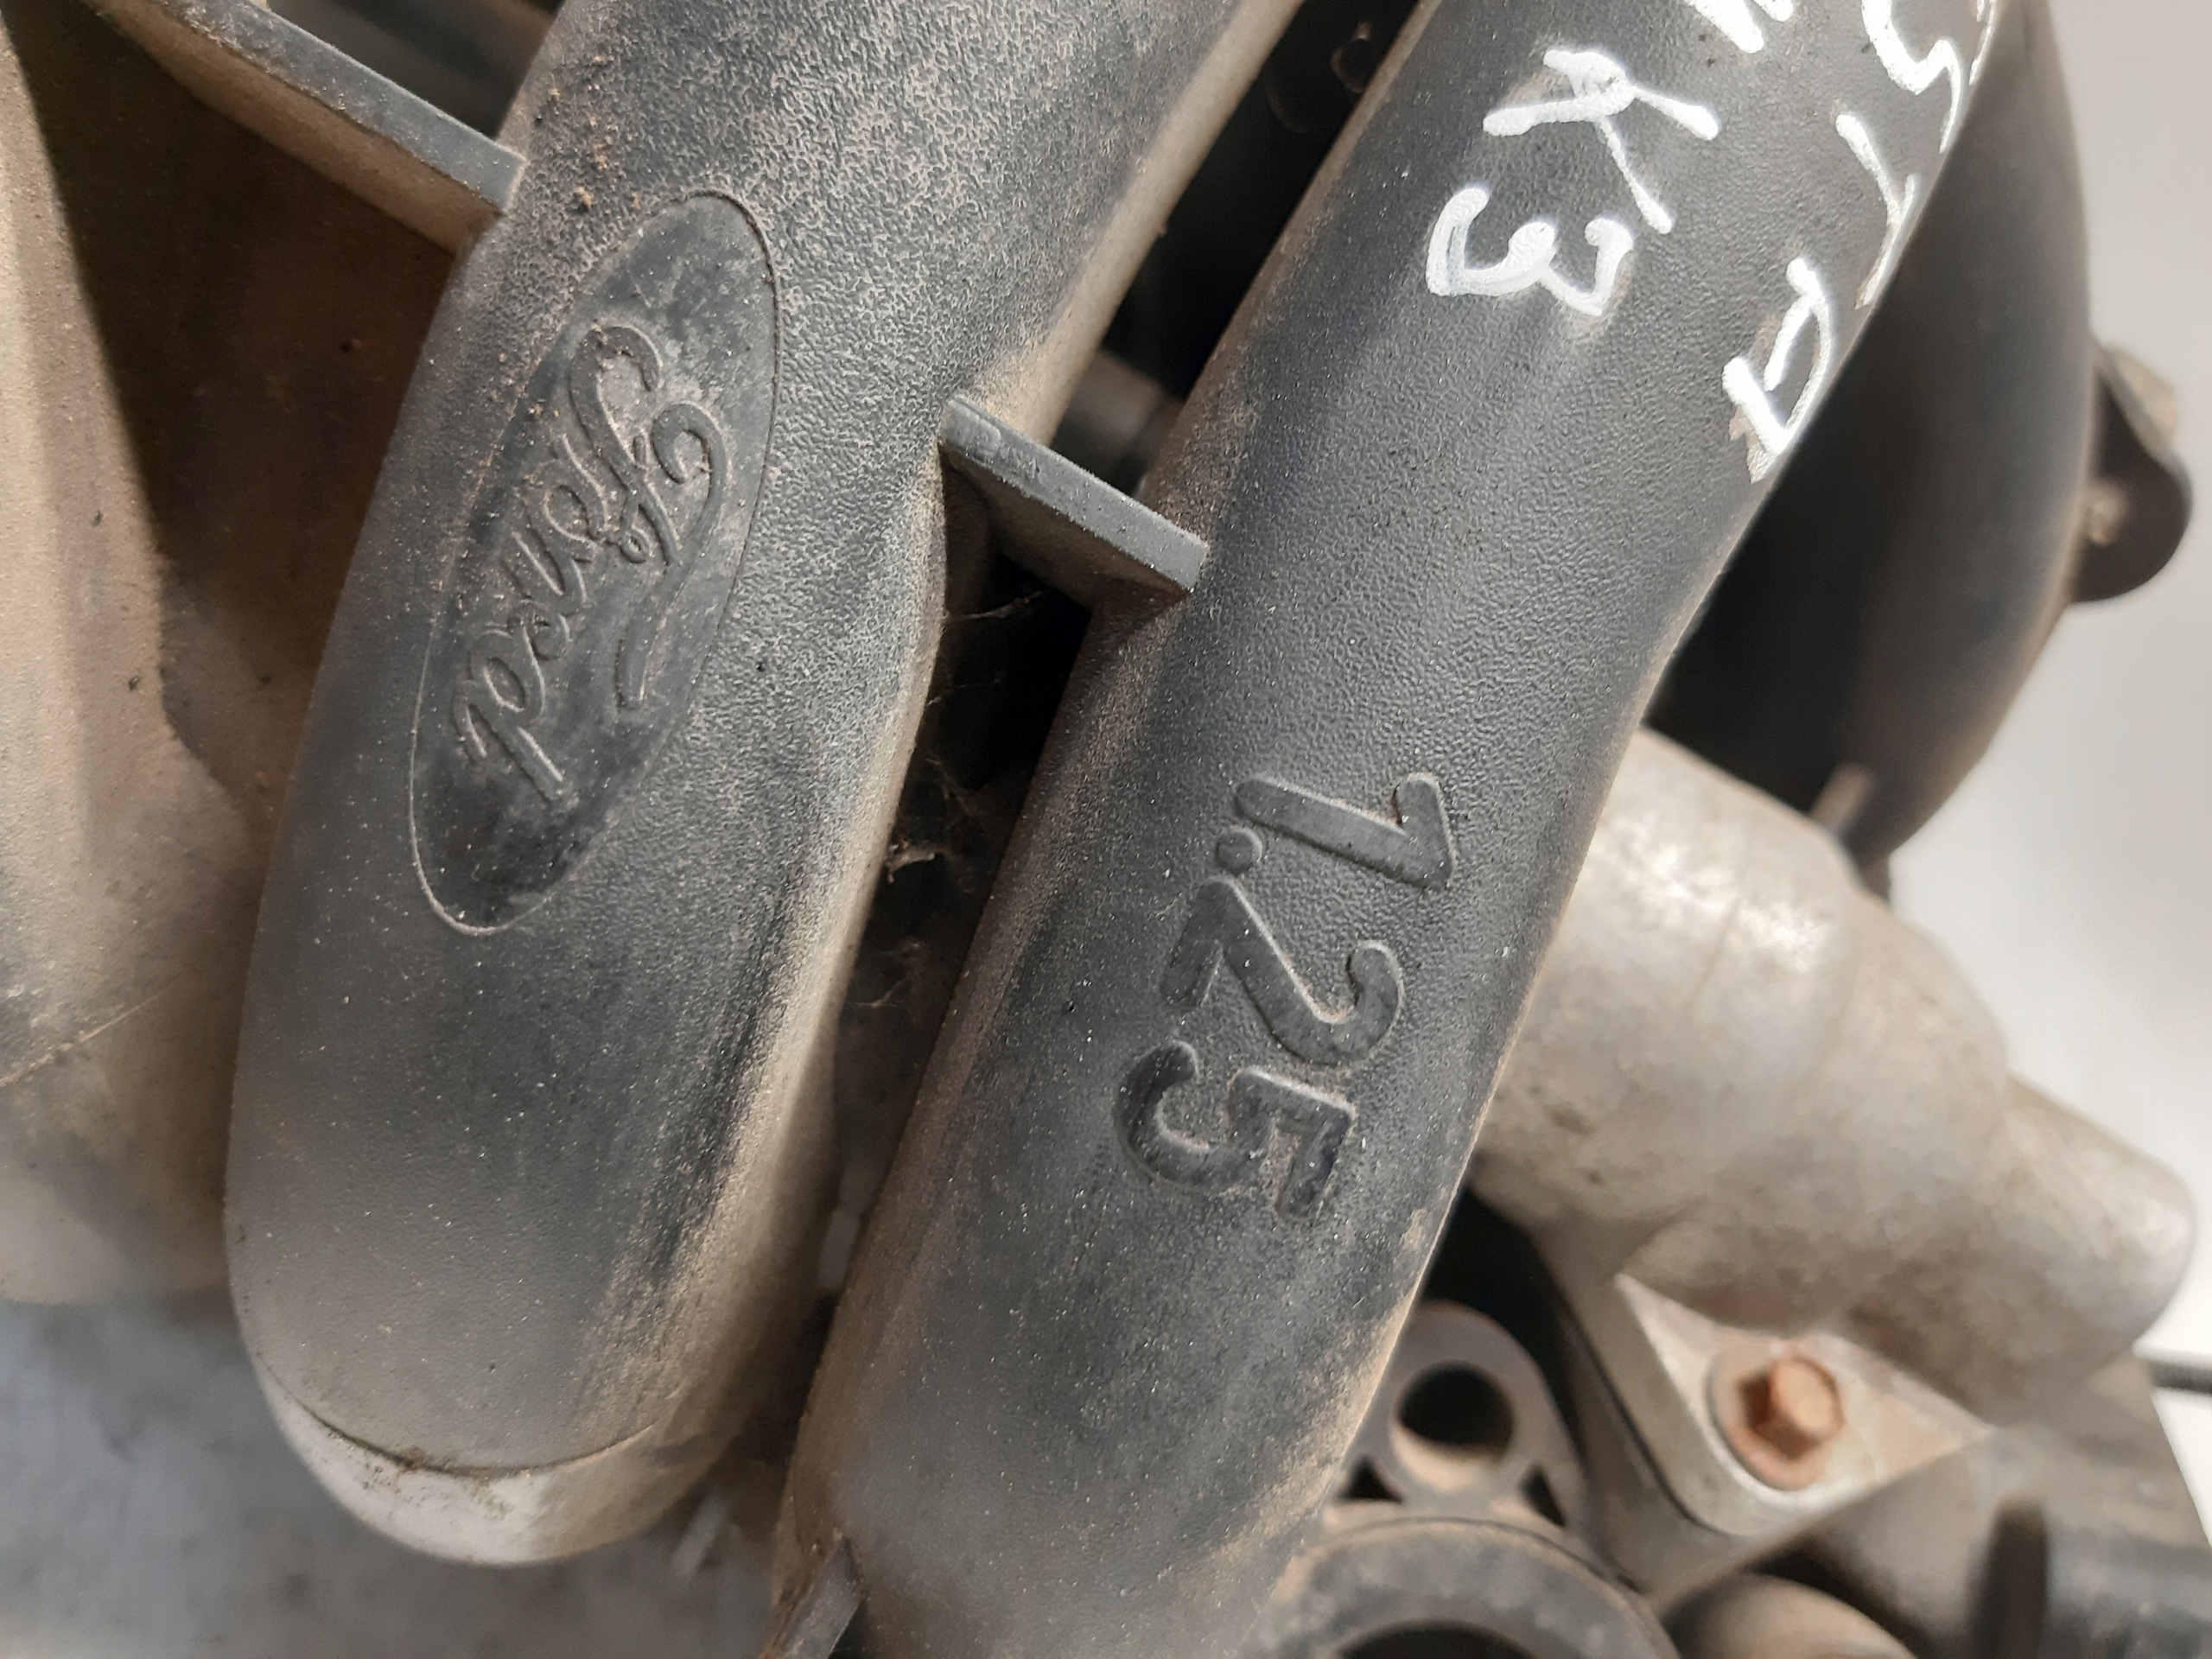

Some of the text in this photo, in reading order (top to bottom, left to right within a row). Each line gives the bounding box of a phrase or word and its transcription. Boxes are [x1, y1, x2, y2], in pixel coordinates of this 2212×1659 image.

[1426, 0, 1794, 316] K3
[451, 323, 728, 807] Ford
[1116, 772, 1459, 1220] 1.25
